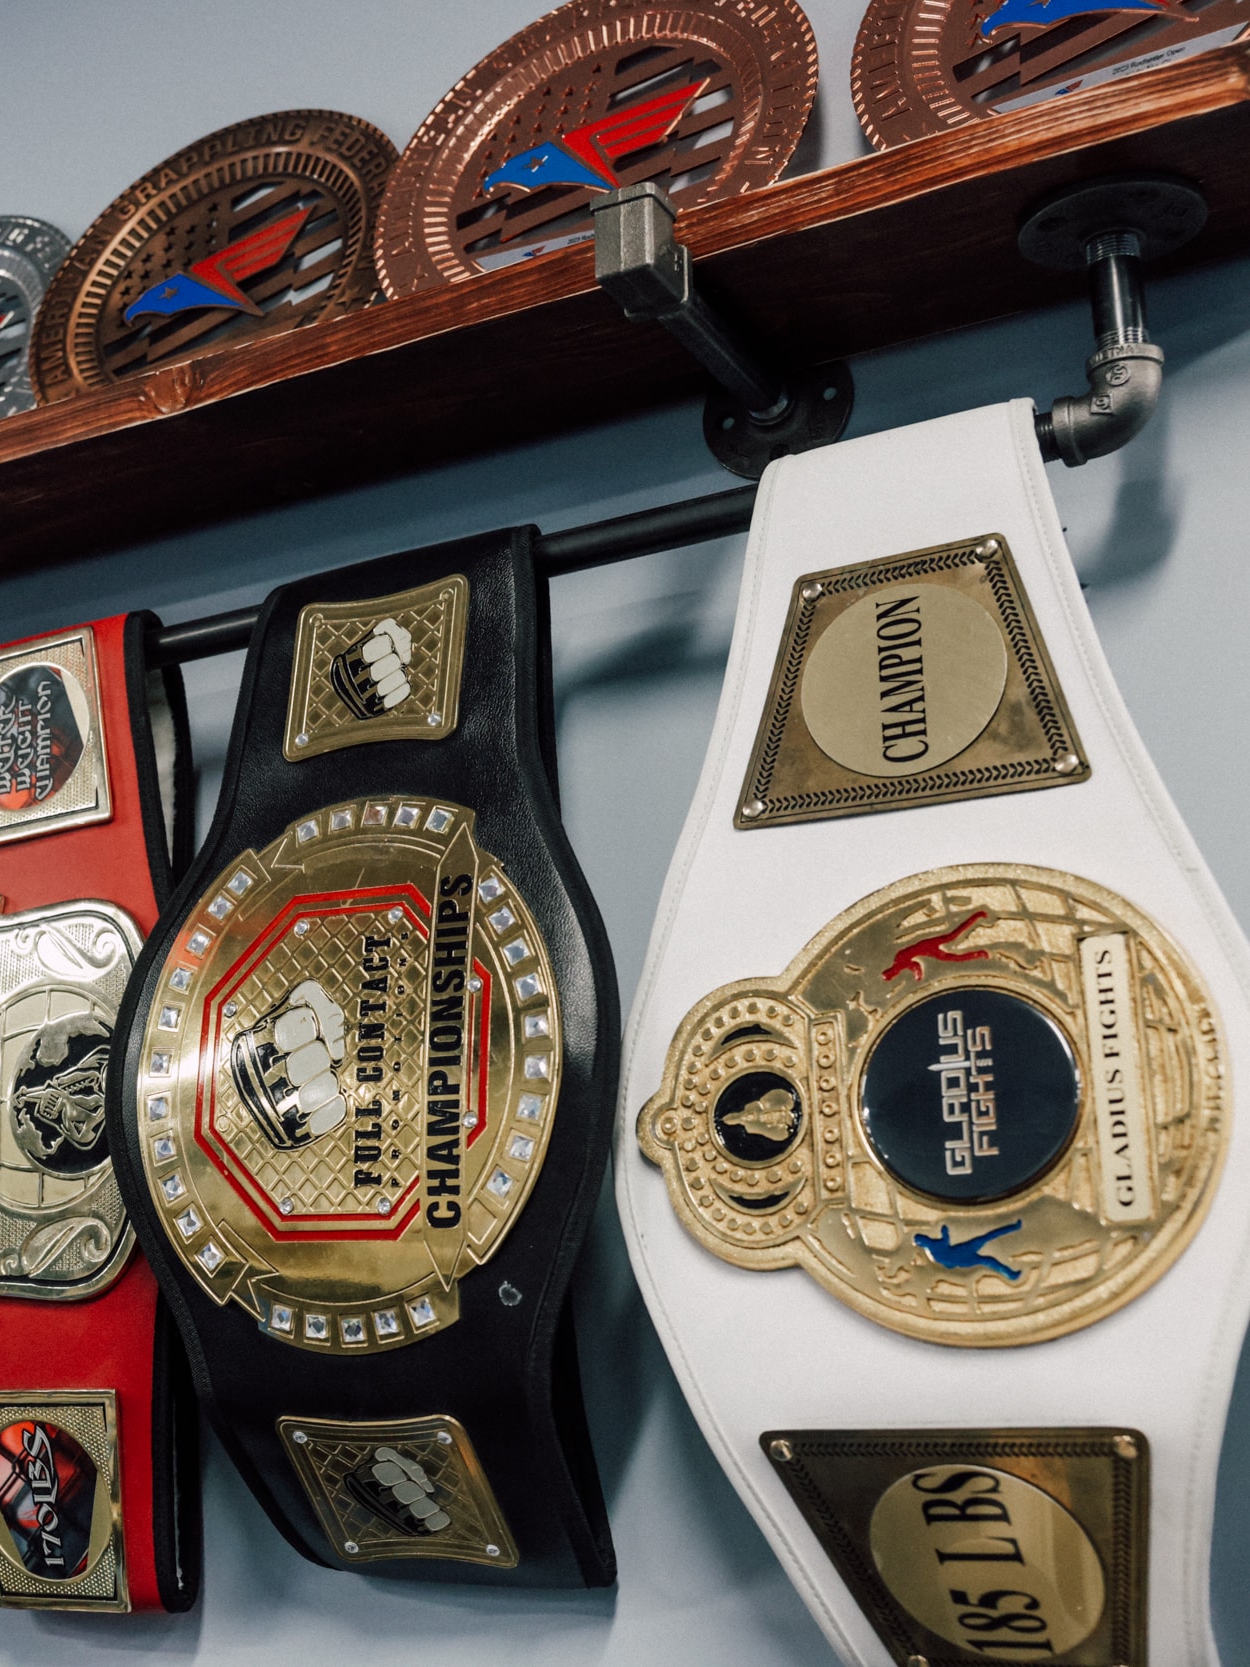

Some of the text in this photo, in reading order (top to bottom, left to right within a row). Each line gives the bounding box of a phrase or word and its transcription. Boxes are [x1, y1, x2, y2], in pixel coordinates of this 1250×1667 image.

[116, 121, 307, 221] GRAPPLING
[16, 700, 34, 791] WEIGHT
[35, 680, 54, 800] CHAMPION
[875, 595, 929, 763] CHAMPION
[354, 934, 392, 1188] FULL CONTACT
[426, 872, 474, 1230] CHAMPIONSHIPS
[936, 1010, 973, 1175] GLADIUS
[967, 1025, 1000, 1157] FIGHTS
[1095, 949, 1137, 1207] GLADIUS FIGHTS
[949, 1589, 1055, 1655] 185
